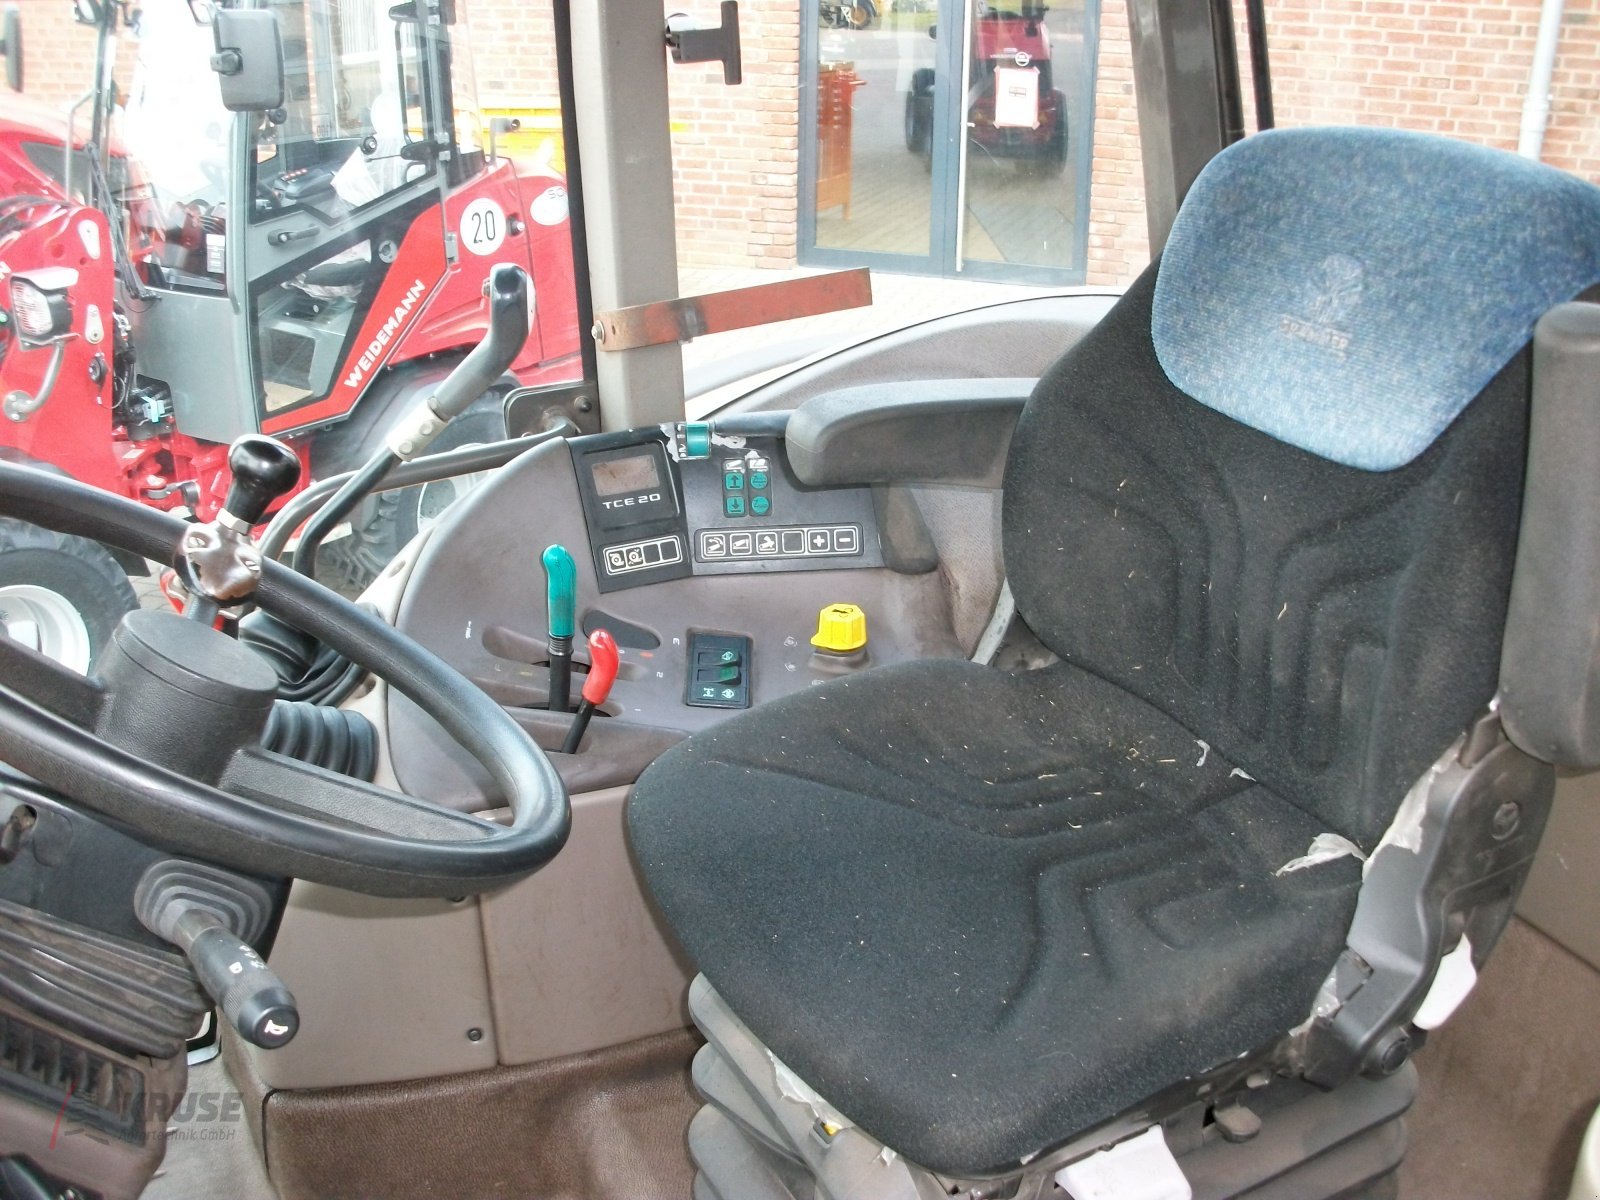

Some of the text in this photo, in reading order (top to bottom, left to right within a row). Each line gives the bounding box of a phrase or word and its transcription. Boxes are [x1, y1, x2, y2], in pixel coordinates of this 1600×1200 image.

[471, 209, 496, 244] 20
[343, 279, 426, 388] WEIDEMANN
[602, 493, 661, 509] TCE 20
